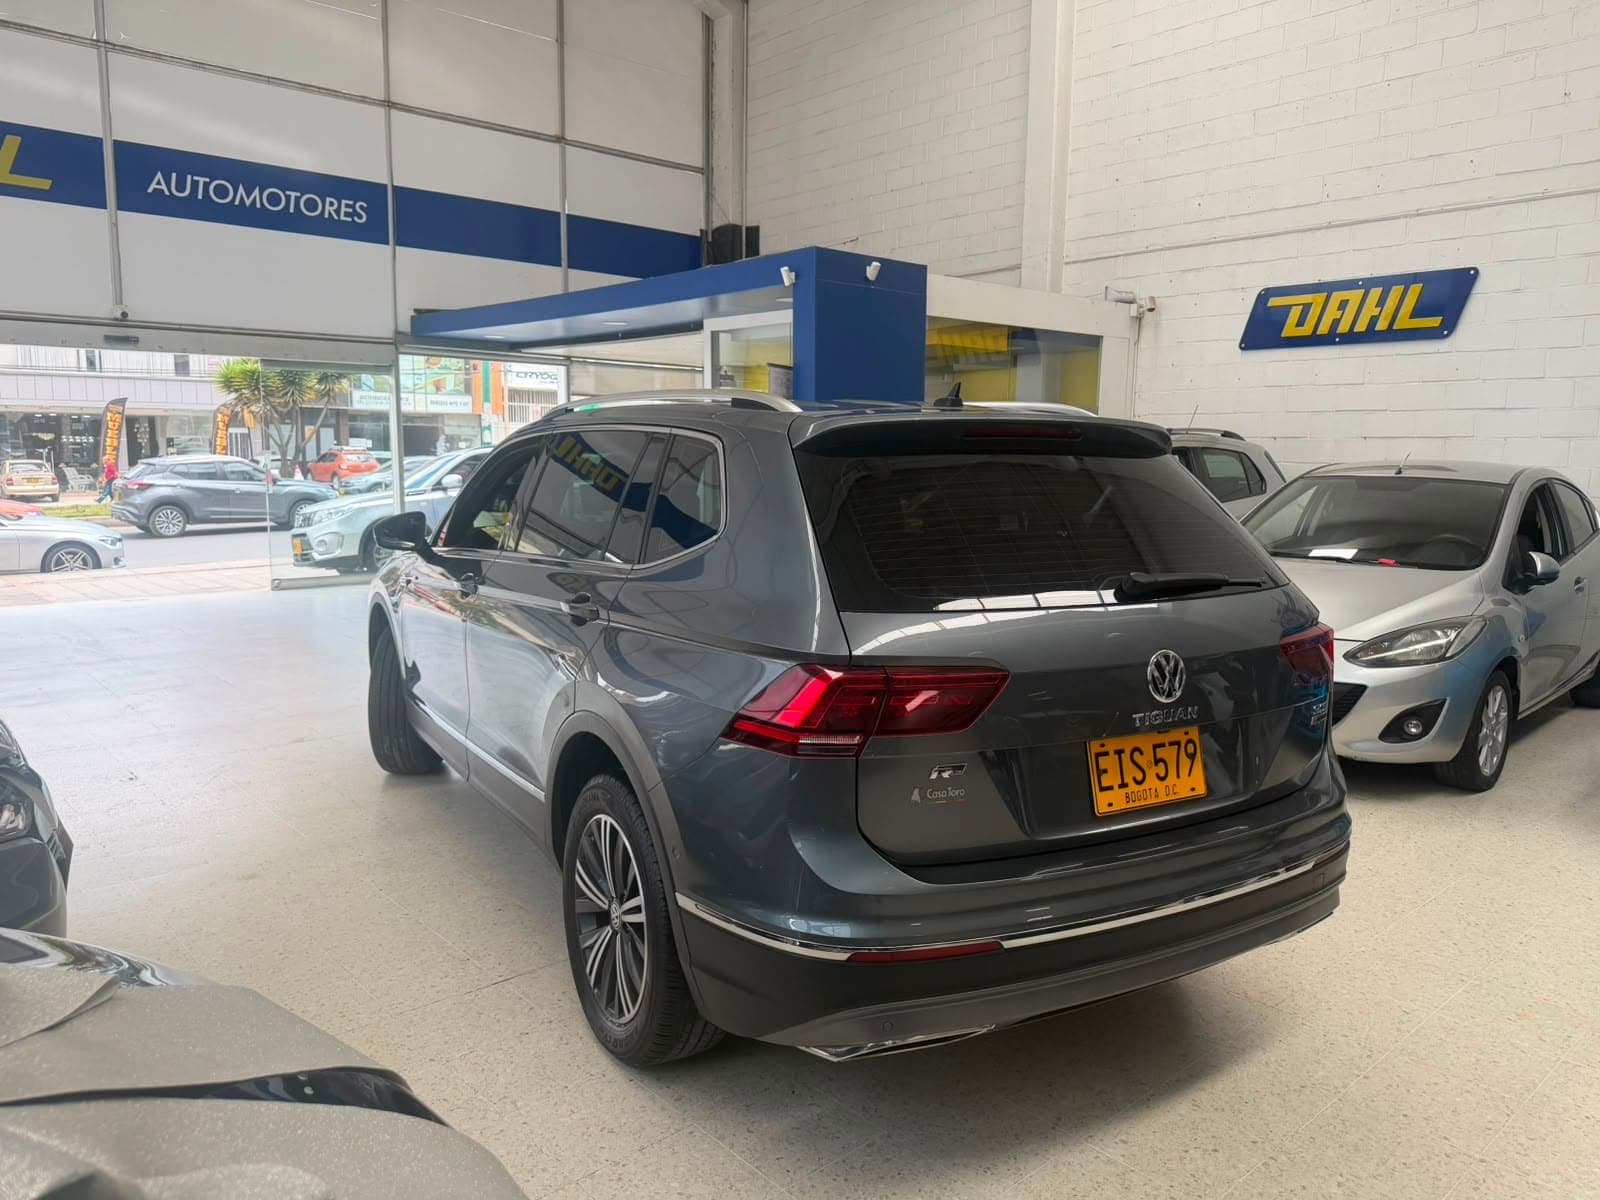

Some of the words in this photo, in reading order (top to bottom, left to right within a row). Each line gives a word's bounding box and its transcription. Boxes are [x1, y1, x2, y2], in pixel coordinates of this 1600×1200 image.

[146, 170, 368, 224] AUTOMOTORES
[1267, 283, 1443, 338] DAHL
[1132, 705, 1200, 727] TIGUAN
[926, 788, 947, 799] Casa
[947, 786, 966, 797] Toro
[1124, 787, 1160, 804] BOGOTA
